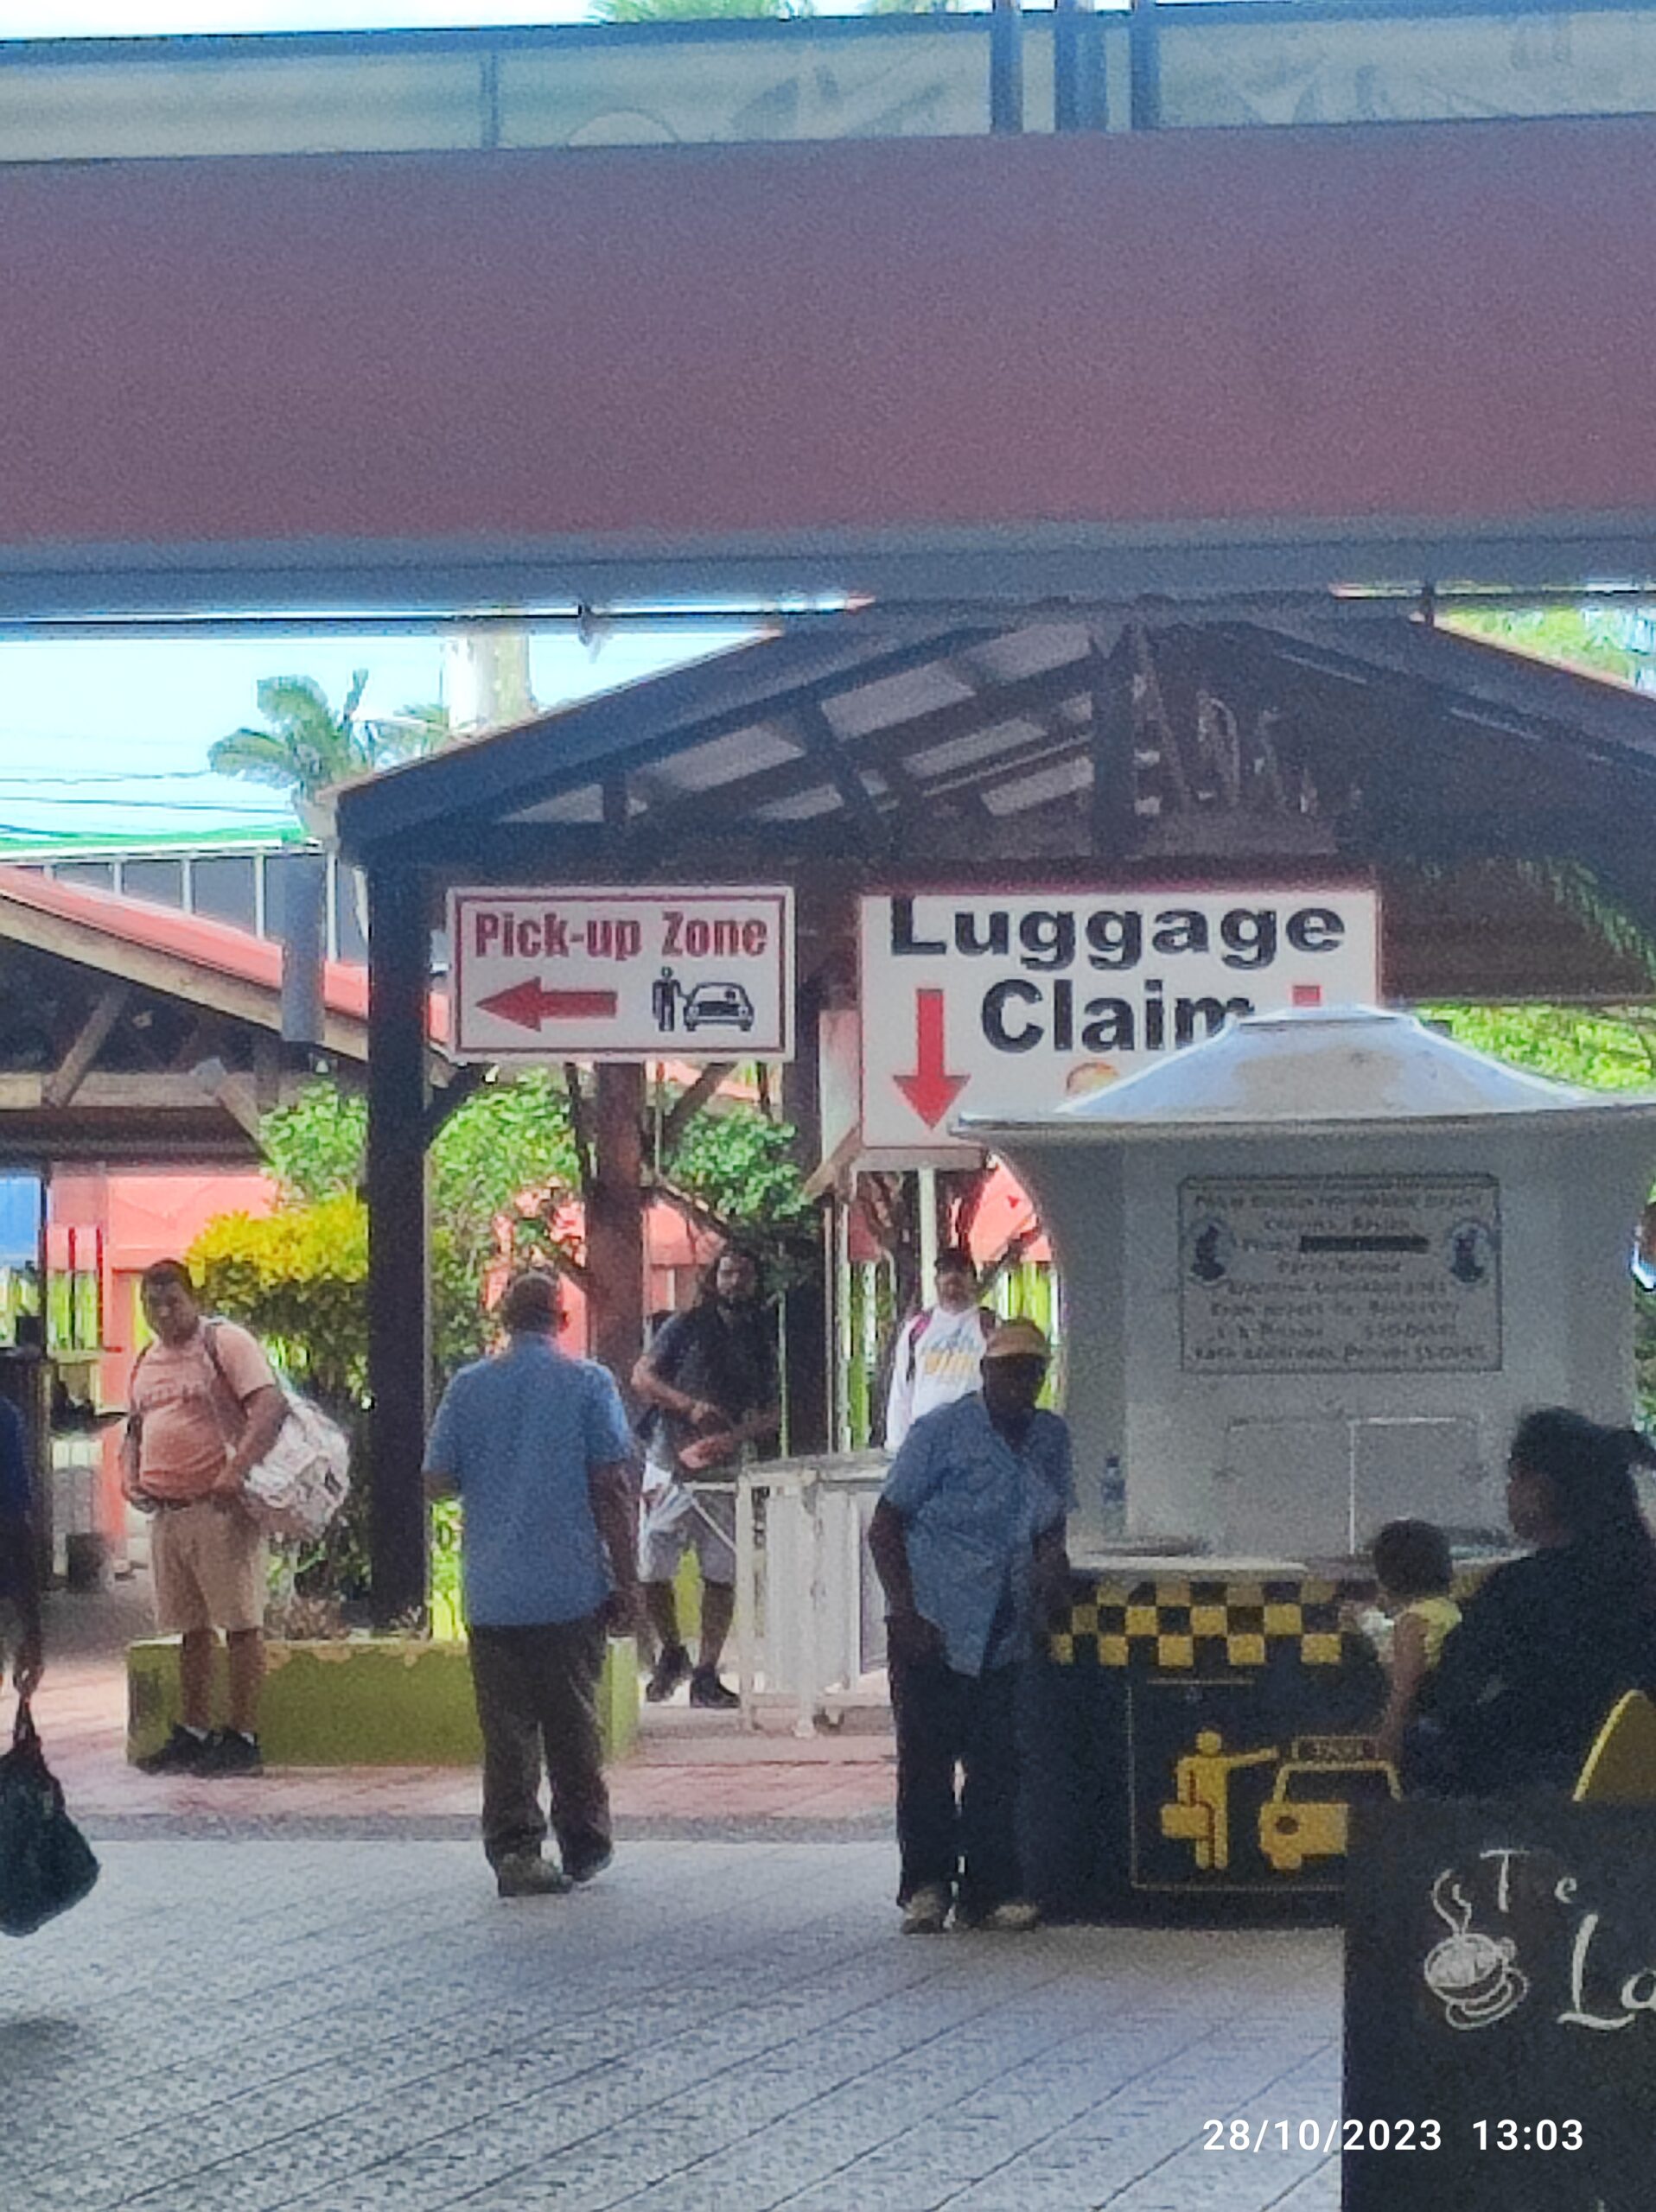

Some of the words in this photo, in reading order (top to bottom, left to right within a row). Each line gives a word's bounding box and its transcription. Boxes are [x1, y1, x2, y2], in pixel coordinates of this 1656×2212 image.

[475, 912, 642, 961] Pick-up
[661, 911, 767, 957] Zone
[890, 895, 1346, 970] Luggage
